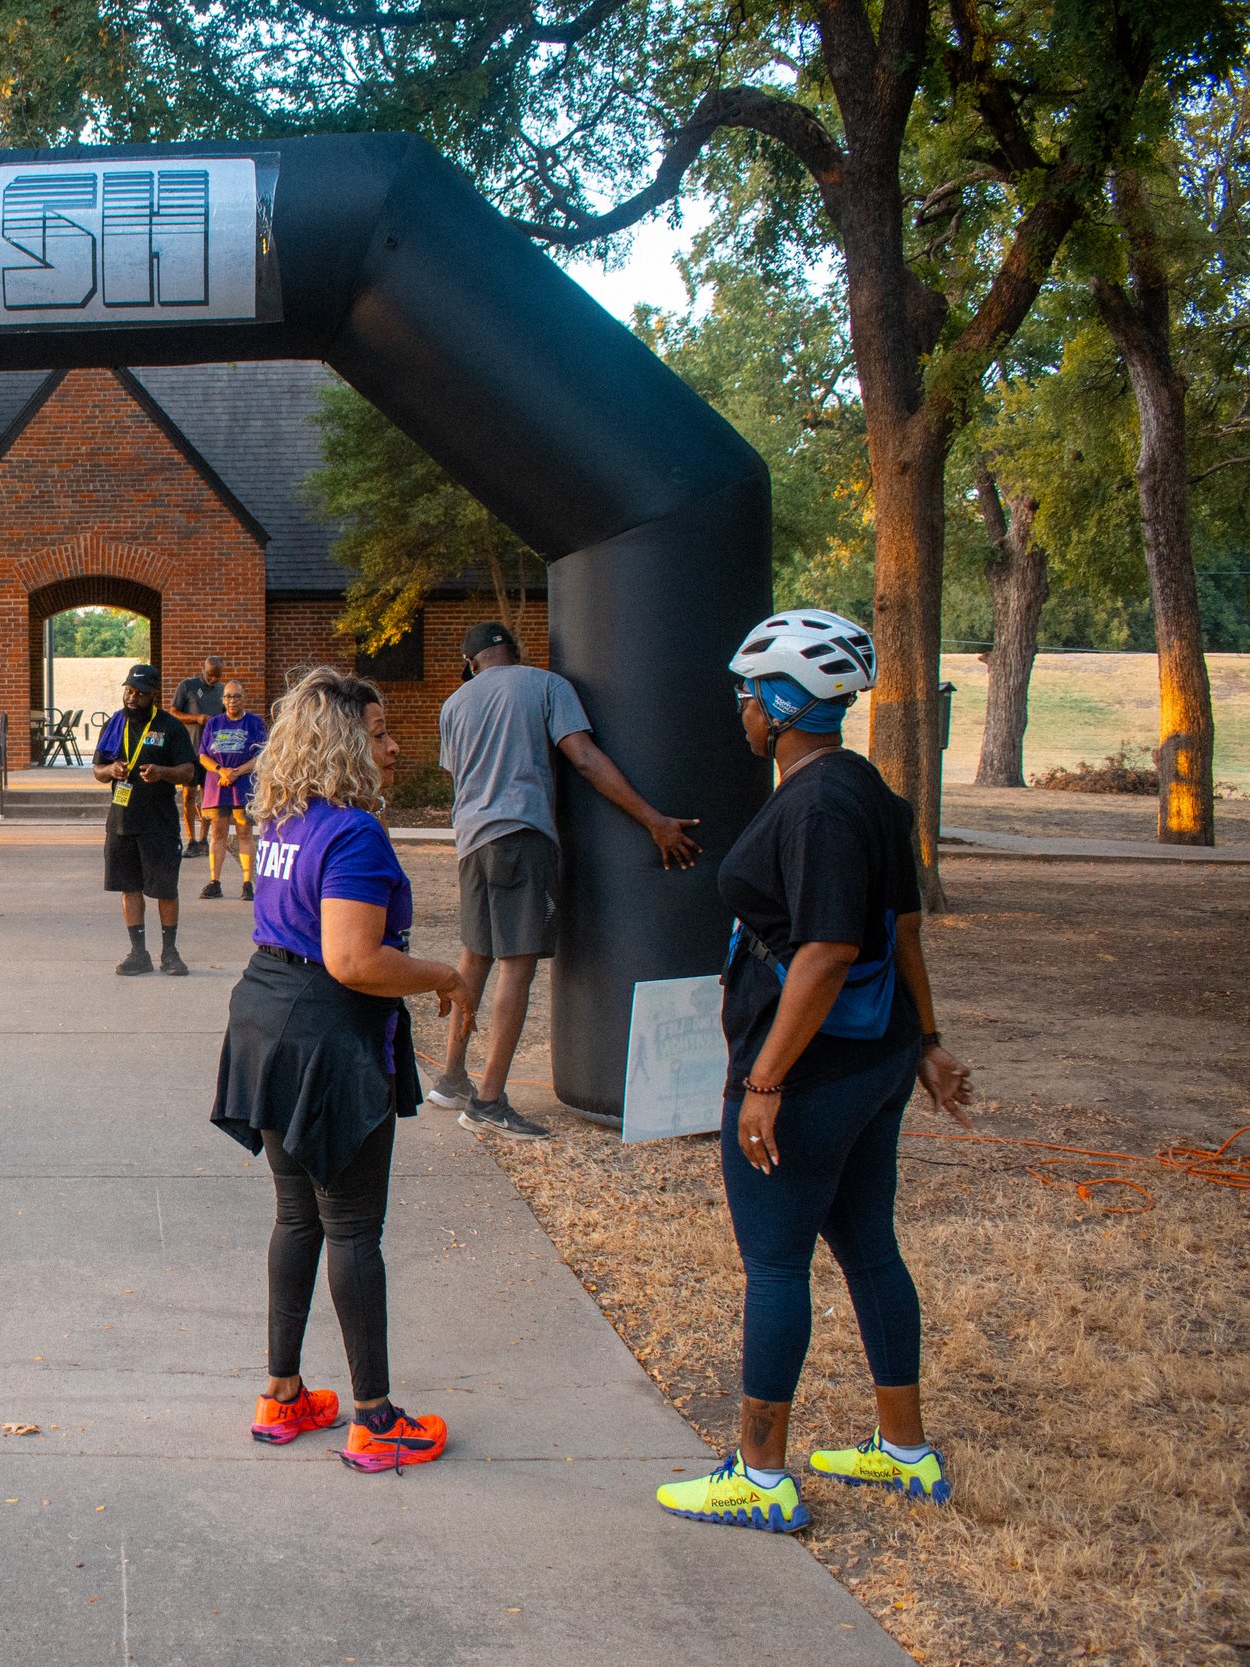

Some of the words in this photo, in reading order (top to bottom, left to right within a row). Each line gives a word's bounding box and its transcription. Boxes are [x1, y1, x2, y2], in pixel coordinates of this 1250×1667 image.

[255, 839, 300, 880] STAFF
[859, 1466, 891, 1478] Reebok
[711, 1496, 748, 1508] Reebok
